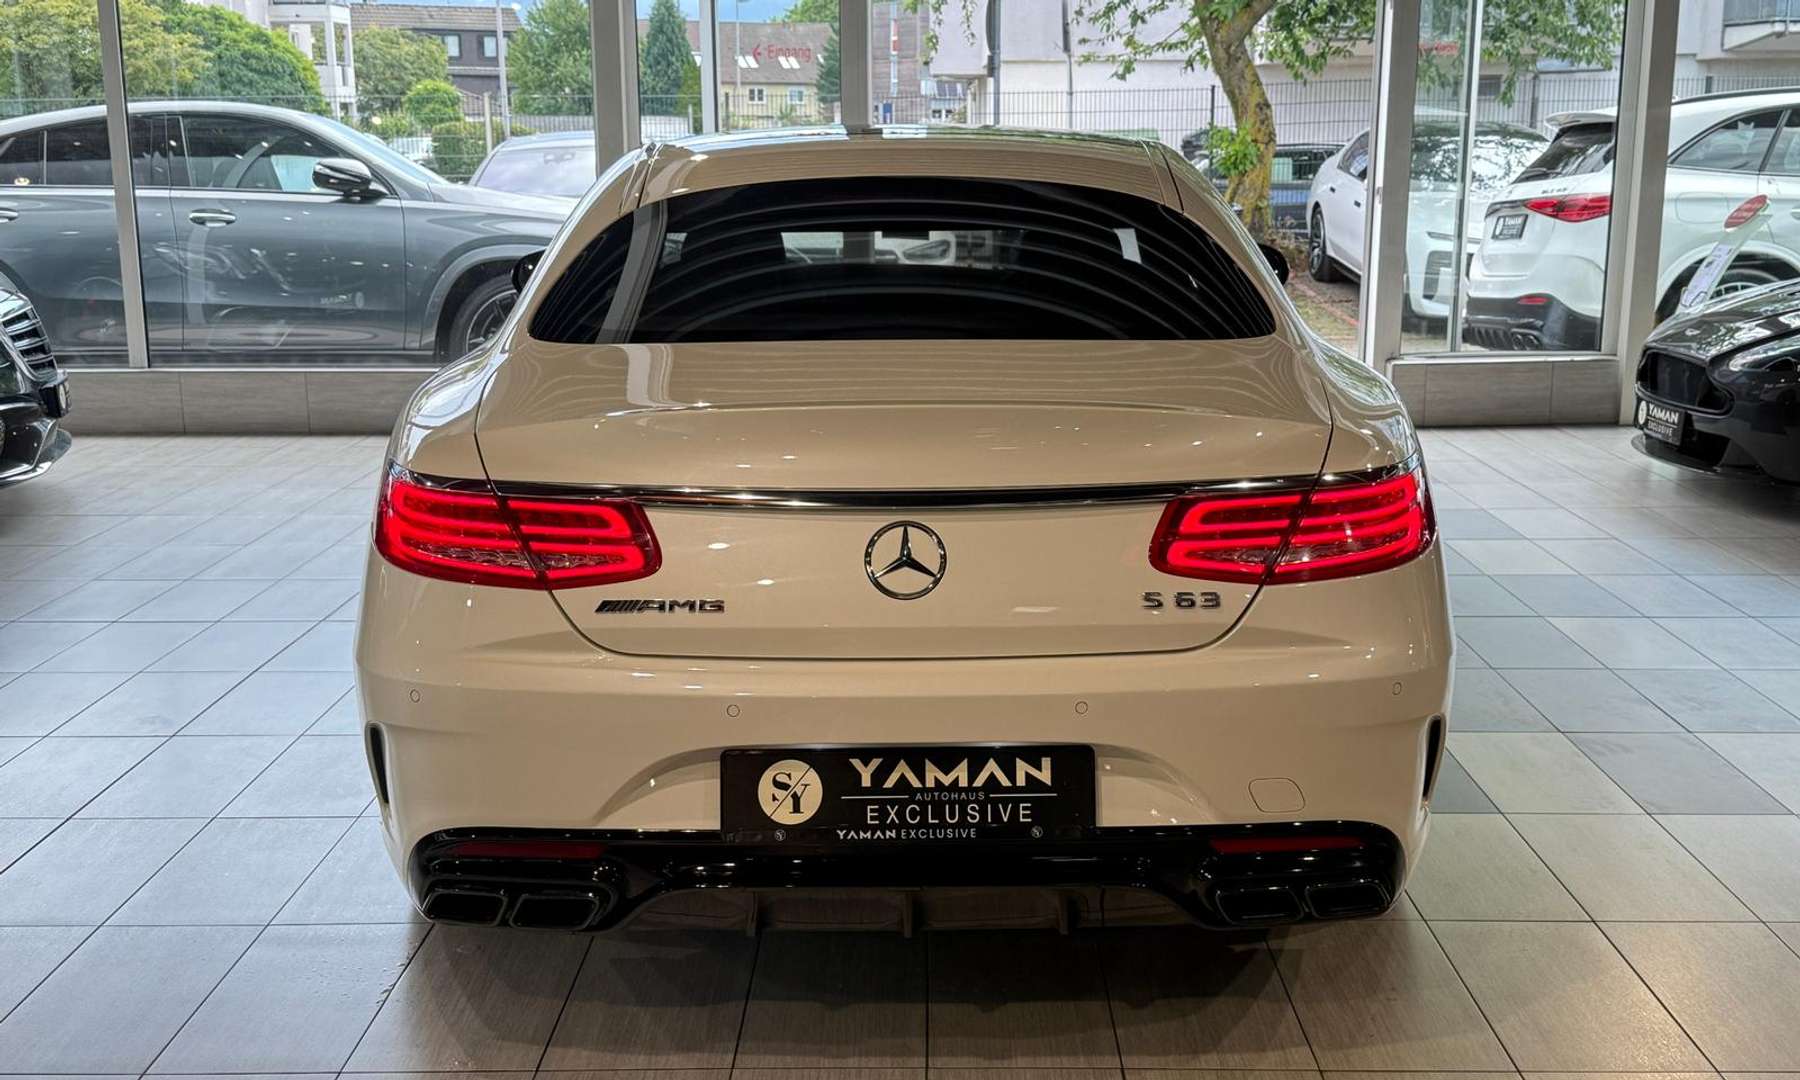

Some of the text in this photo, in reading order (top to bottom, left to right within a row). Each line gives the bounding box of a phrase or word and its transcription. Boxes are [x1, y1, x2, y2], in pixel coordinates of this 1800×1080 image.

[767, 44, 812, 63] Eingang
[1649, 403, 1679, 424] YAMAN
[637, 599, 725, 613] AMG
[1142, 591, 1221, 609] S 63
[848, 757, 1052, 788] YAMAN
[915, 791, 985, 801] AUTOHAUS
[867, 803, 1033, 825] EXCLUSIVE
[836, 828, 977, 840] YAMAN EXCLUSIVE
